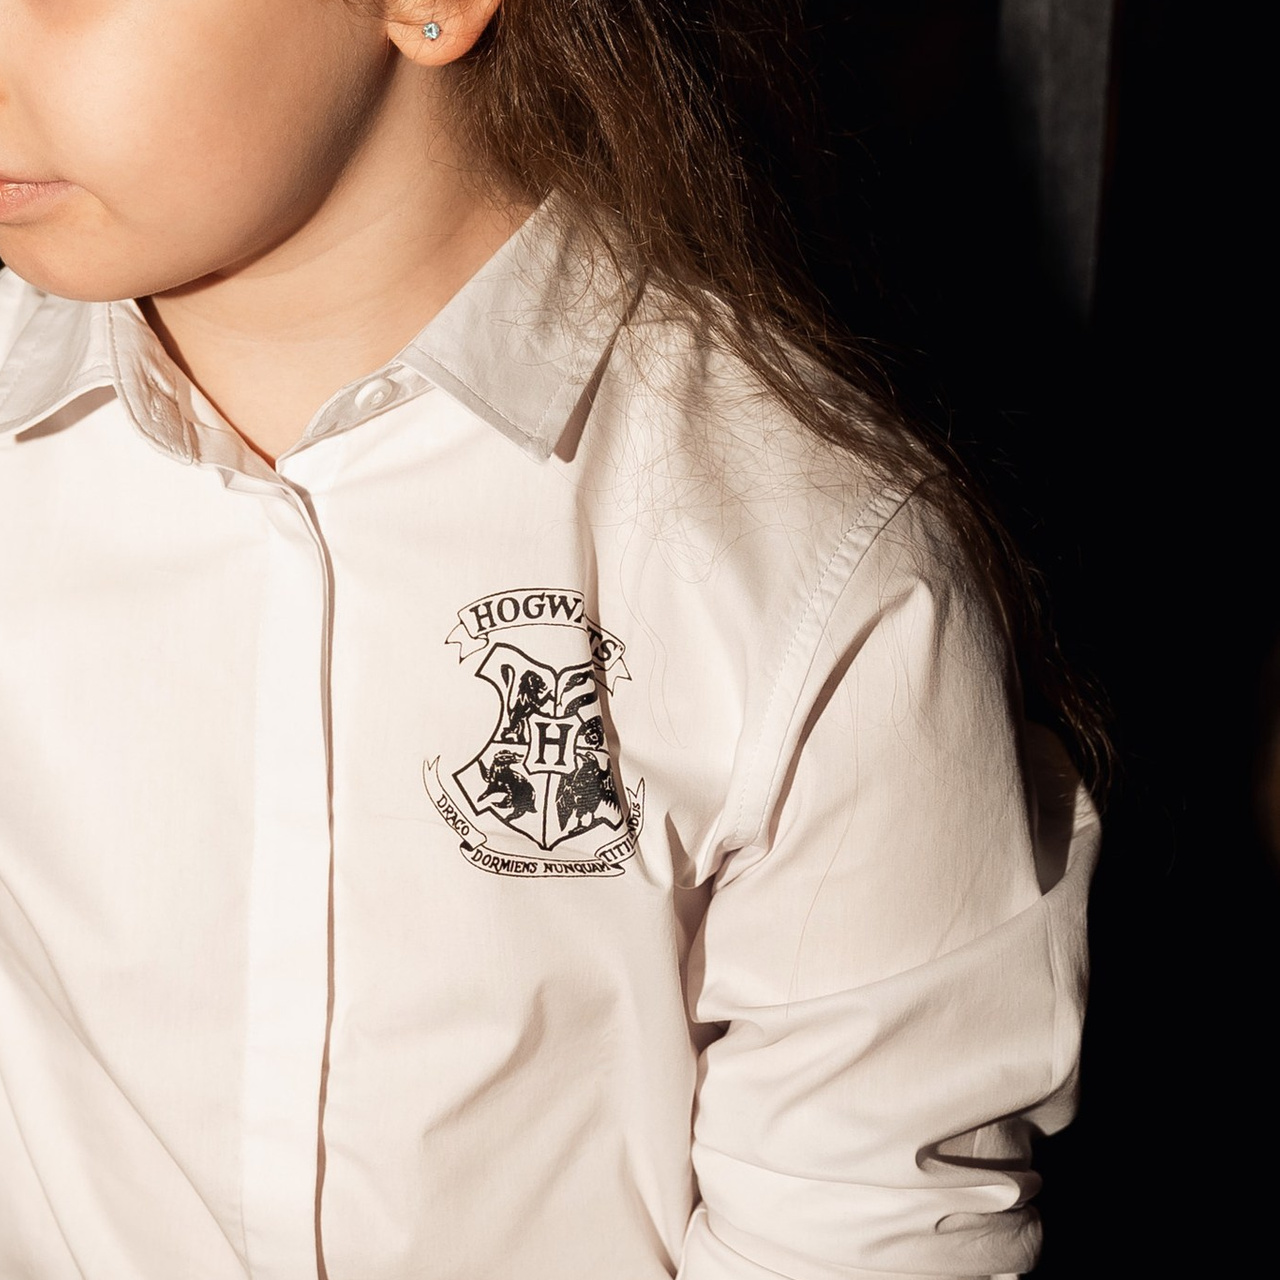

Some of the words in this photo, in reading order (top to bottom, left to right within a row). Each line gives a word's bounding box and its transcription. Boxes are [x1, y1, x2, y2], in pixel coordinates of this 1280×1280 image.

[469, 592, 619, 662] HOGWTS
[534, 721, 575, 767] H
[435, 793, 471, 837] DRACO
[470, 849, 539, 875] DORMIENS
[542, 861, 612, 875] NUNQUAM
[598, 802, 642, 863] TITILNDUS
